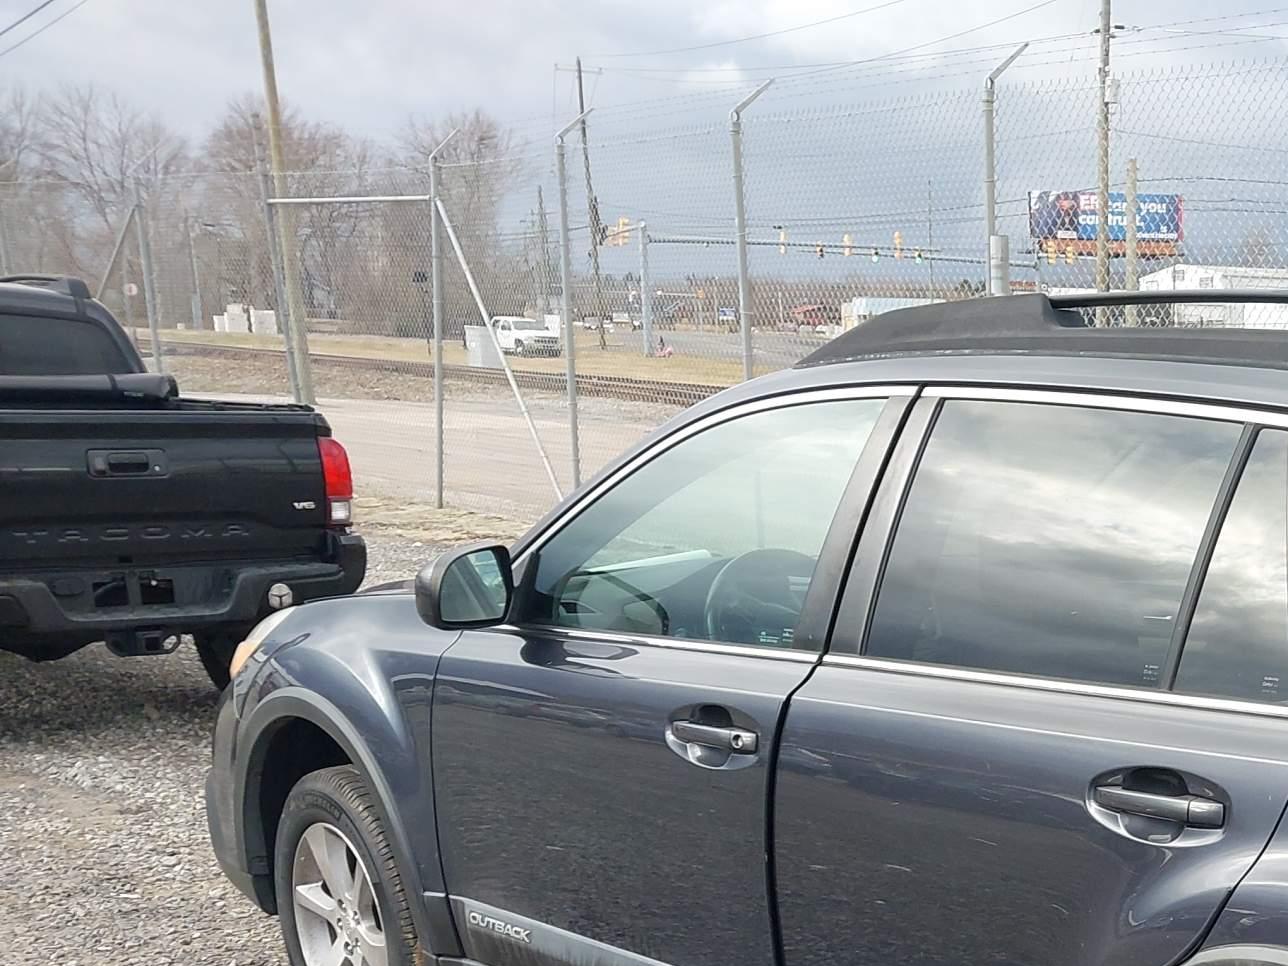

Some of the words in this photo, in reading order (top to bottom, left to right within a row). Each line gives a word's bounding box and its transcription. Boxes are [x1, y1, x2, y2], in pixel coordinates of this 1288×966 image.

[1140, 203, 1167, 216] you
[1107, 213, 1144, 227] trut.
[293, 502, 316, 510] V6
[10, 524, 250, 544] TACOMA
[469, 912, 531, 943] OUTBACK
